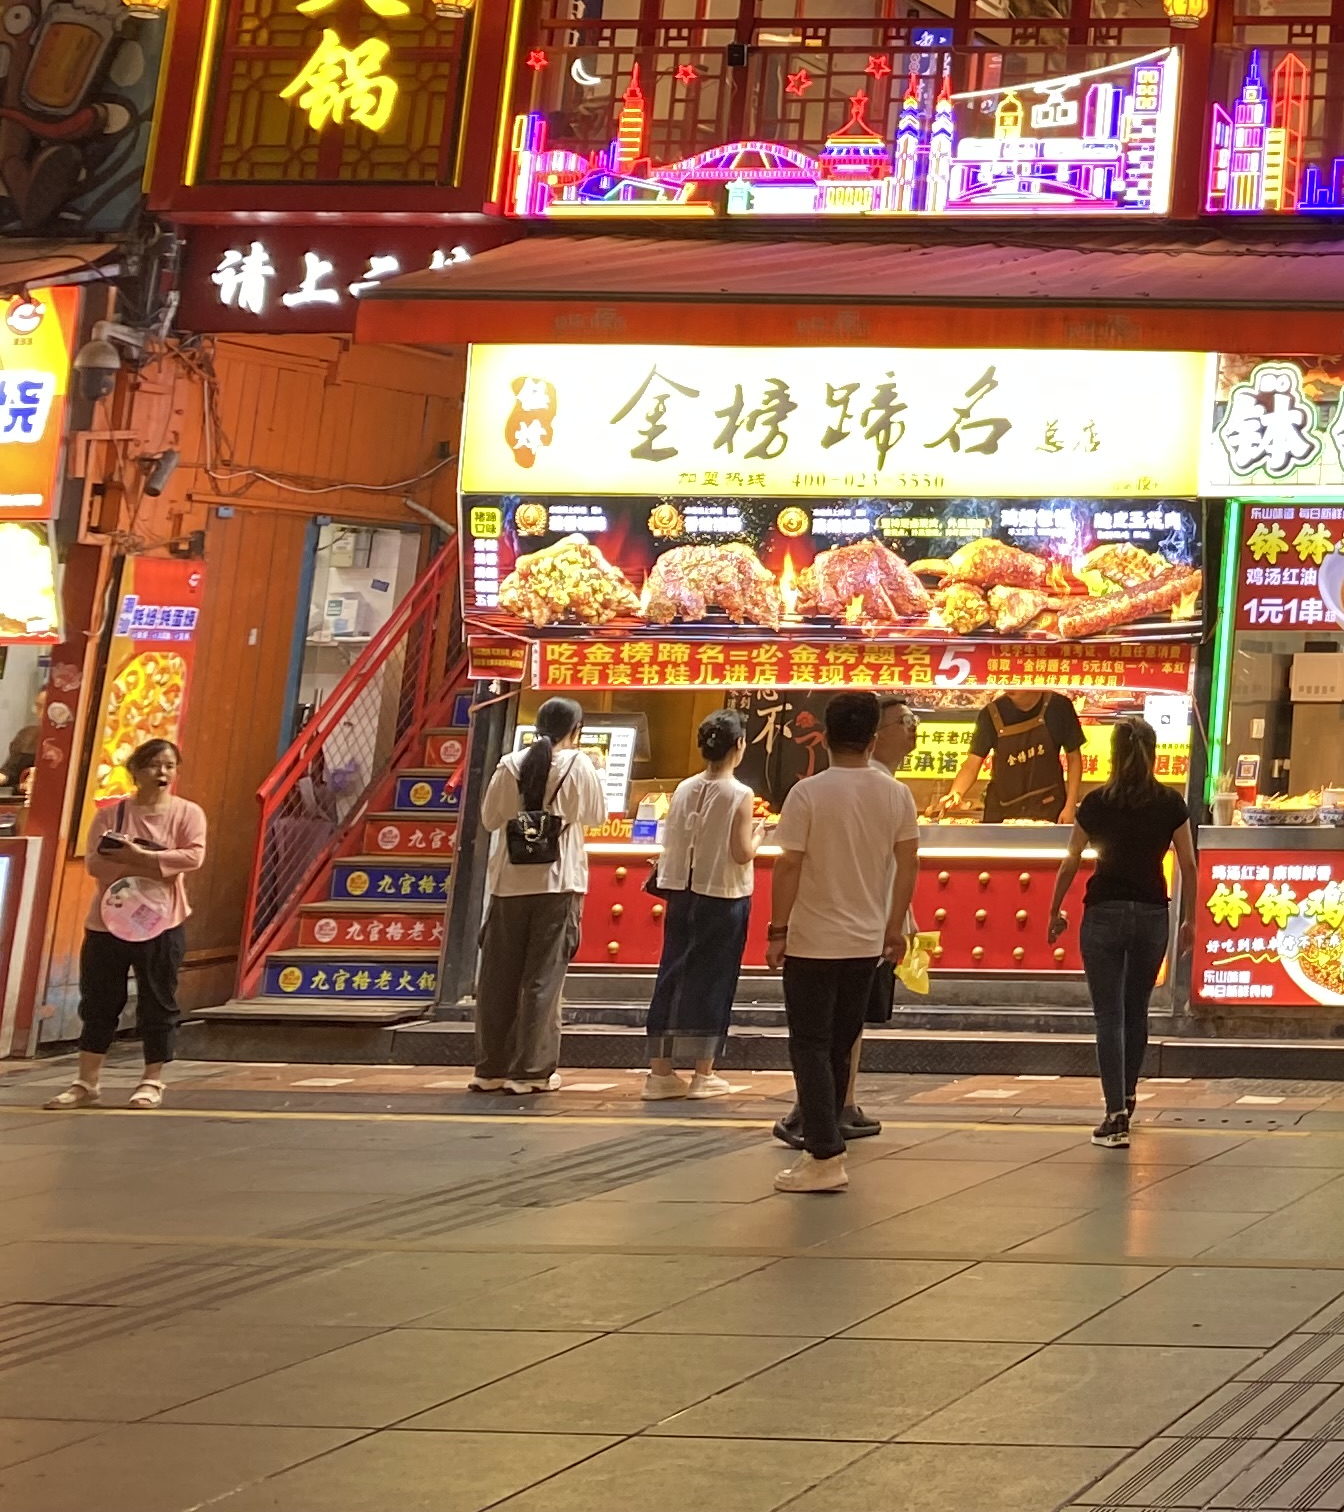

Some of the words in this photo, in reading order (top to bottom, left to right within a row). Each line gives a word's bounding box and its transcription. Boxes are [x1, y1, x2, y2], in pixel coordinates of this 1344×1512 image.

[609, 364, 1012, 471] 金榜蹄名
[474, 523, 498, 535] 口味
[1246, 567, 1318, 586] 鸡汤红油
[547, 663, 778, 686] 所有读书娃儿进店
[789, 665, 933, 687] 送现金红包
